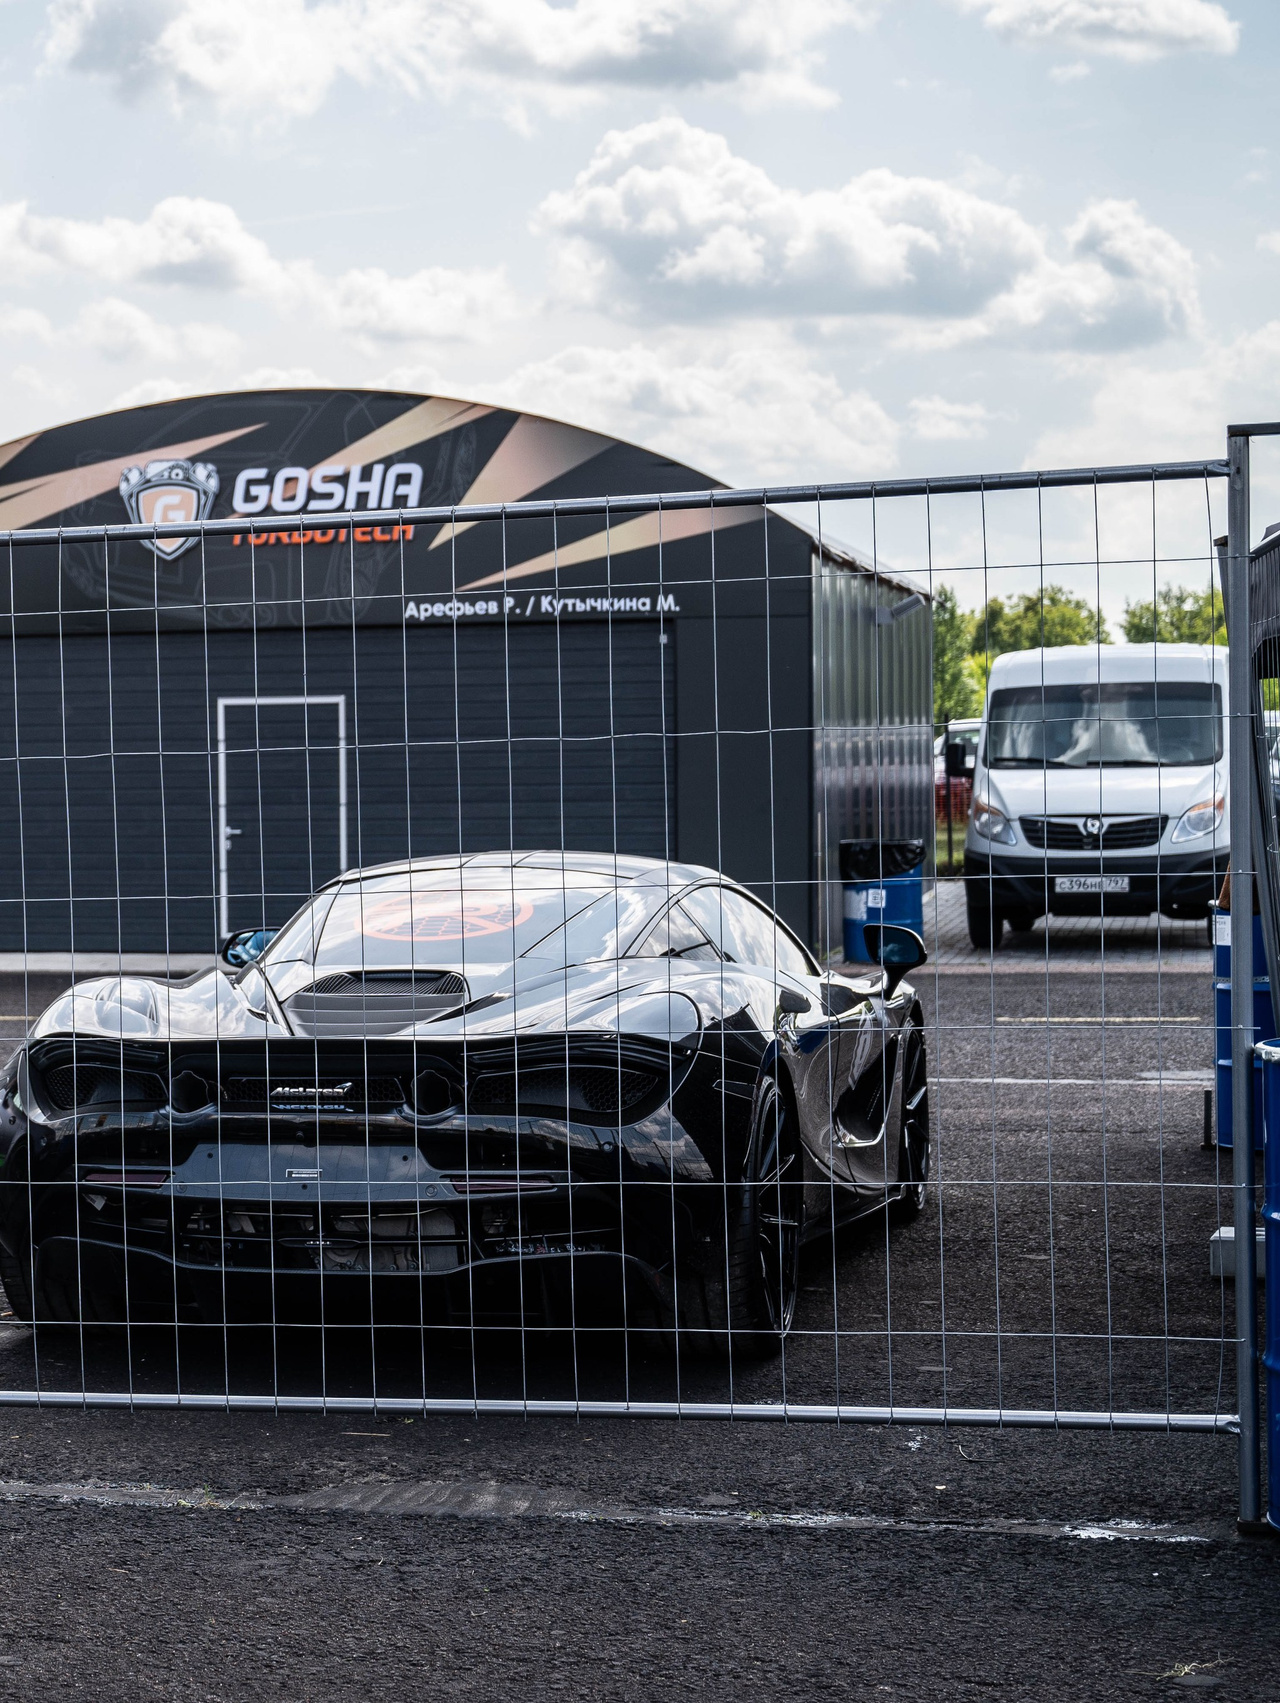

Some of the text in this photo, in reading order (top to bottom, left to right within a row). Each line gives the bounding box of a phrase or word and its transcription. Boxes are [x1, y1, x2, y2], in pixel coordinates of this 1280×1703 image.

[233, 463, 423, 513] GOSHA
[405, 600, 498, 620] Арефьев
[503, 596, 521, 614] Р.
[540, 595, 651, 616] Кутычкина
[657, 594, 681, 612] М.
[270, 1085, 348, 1097] McLaren
